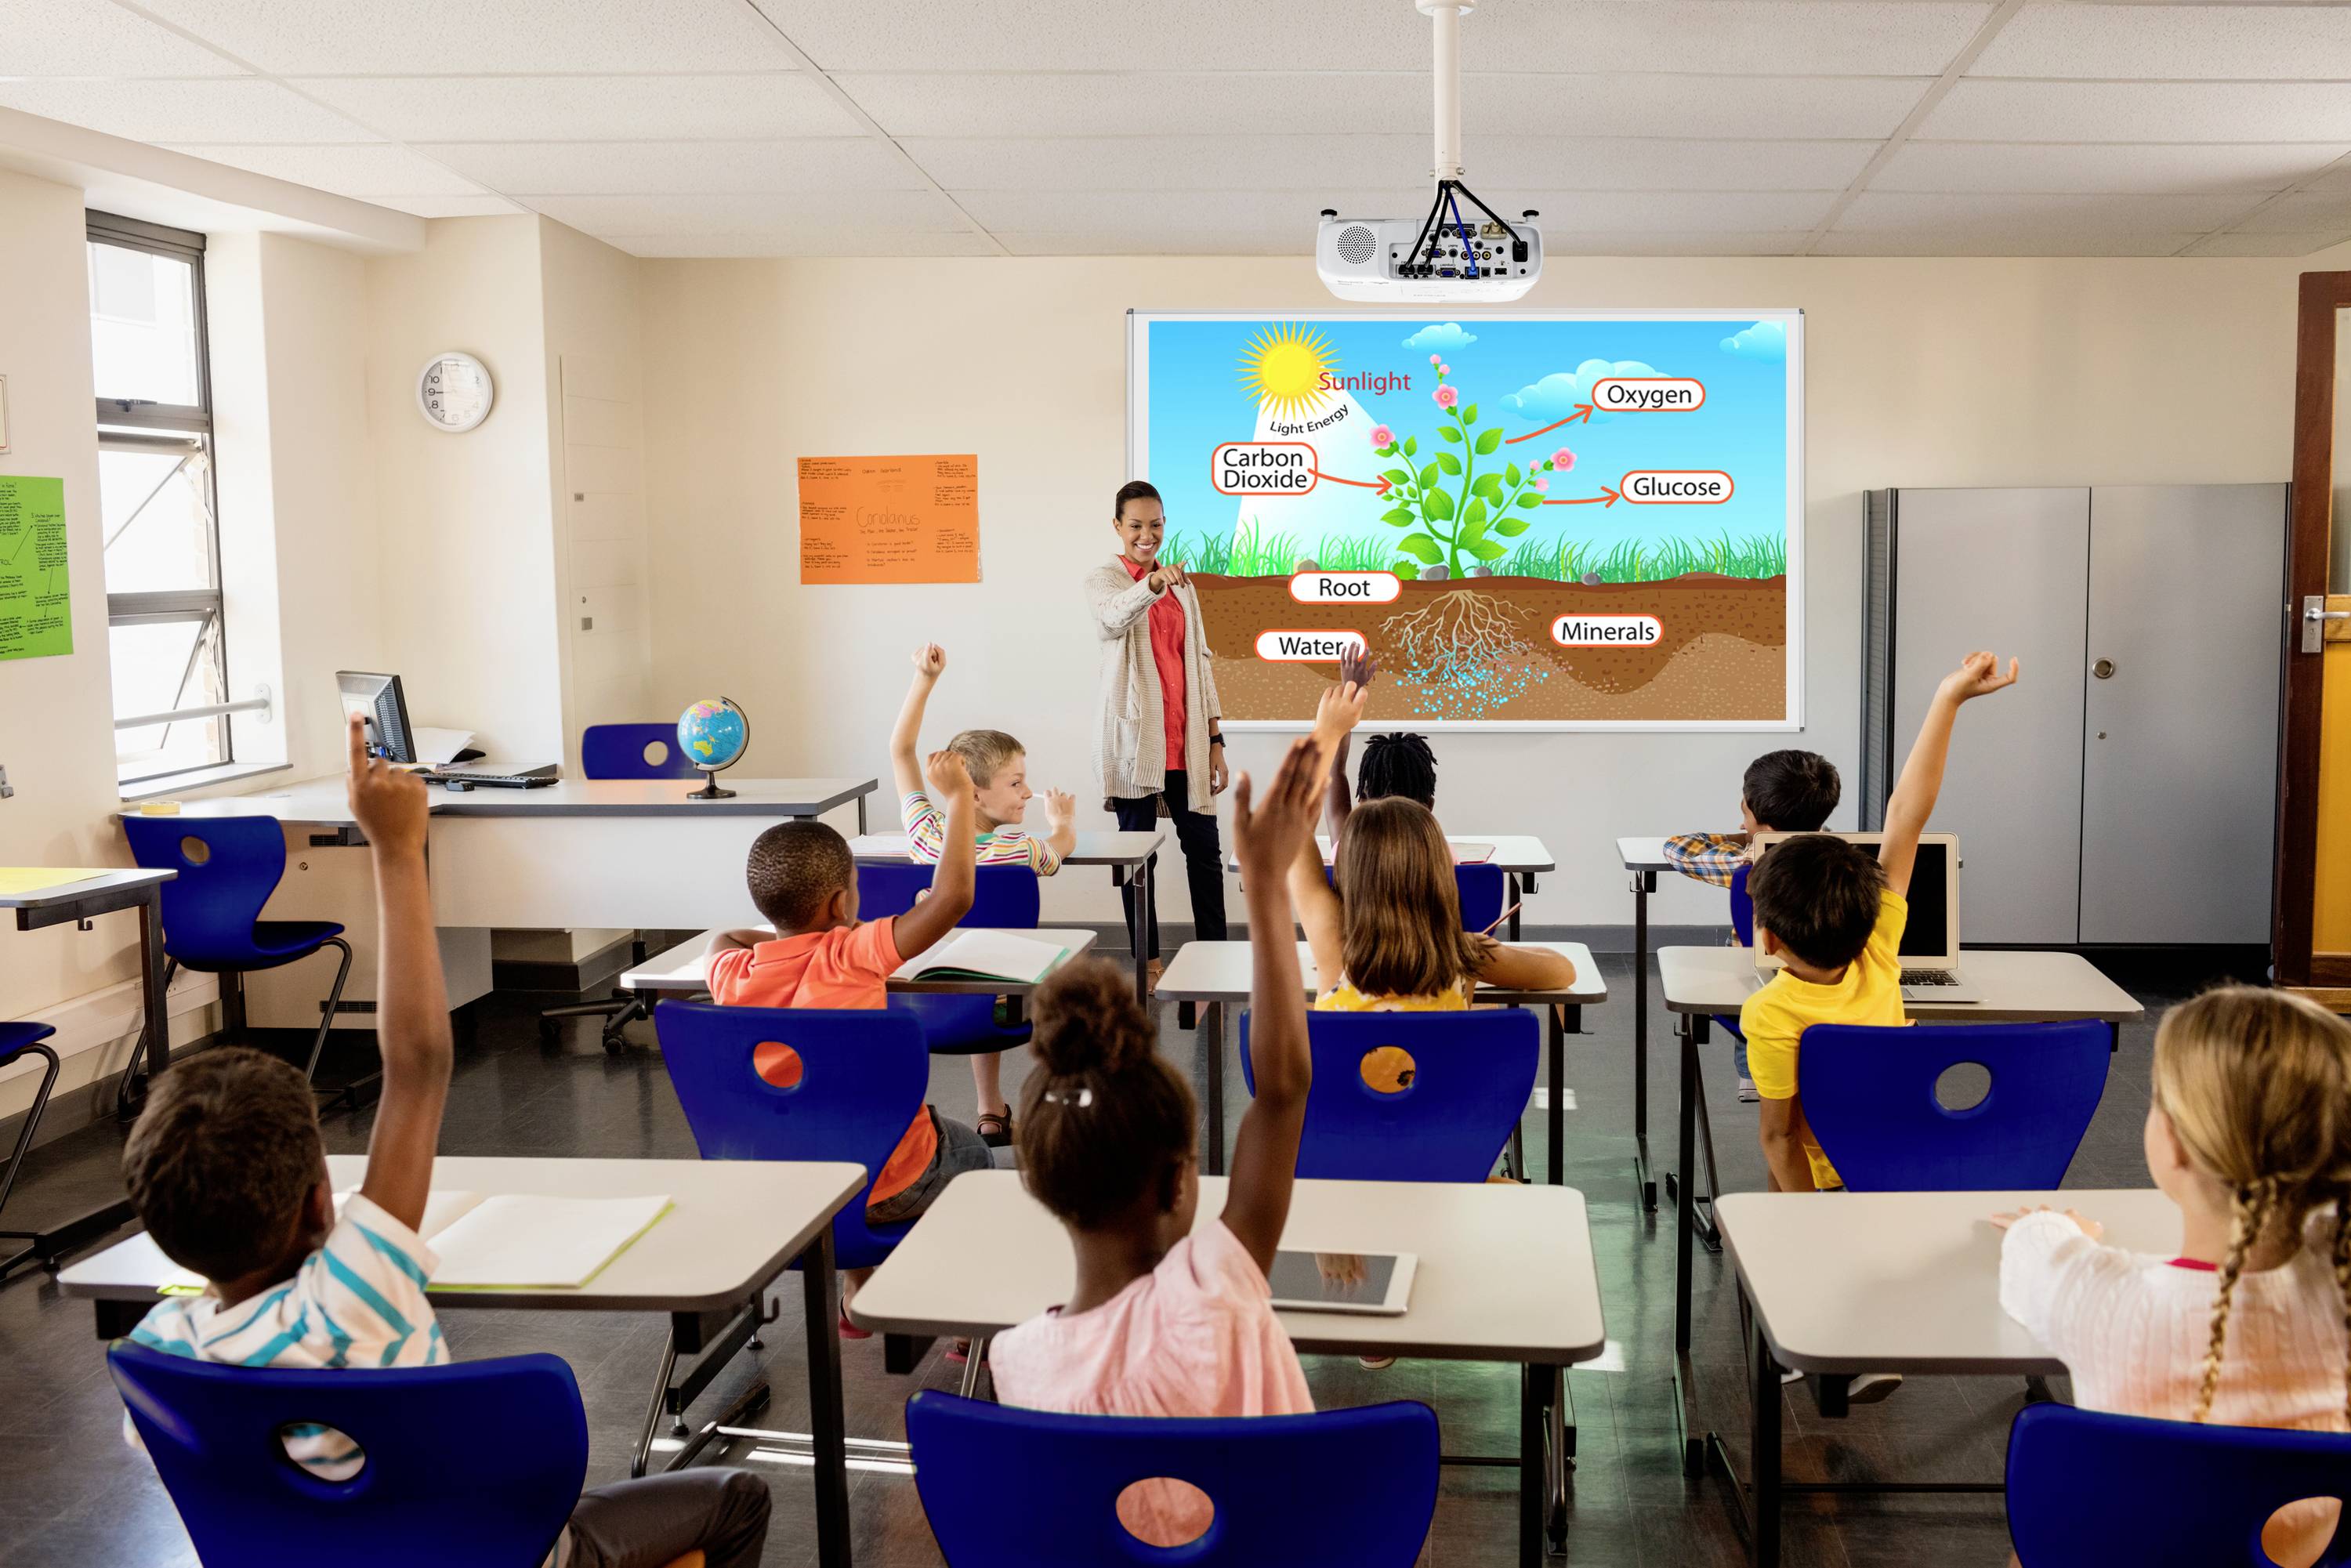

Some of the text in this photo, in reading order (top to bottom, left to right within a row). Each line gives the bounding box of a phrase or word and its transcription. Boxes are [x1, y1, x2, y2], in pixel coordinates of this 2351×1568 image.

[430, 375, 440, 384] 10
[1319, 372, 1411, 396] Sunlight
[428, 388, 436, 397] 9
[1607, 385, 1692, 409] Oxygen
[431, 400, 439, 409] 8
[1270, 404, 1349, 436] Light Energy
[1223, 447, 1303, 467] Carbon
[1224, 469, 1308, 489] Dioxide
[1633, 476, 1721, 497] Glucose
[856, 505, 921, 528] Coriolanus
[1320, 578, 1371, 597] Root
[1562, 621, 1654, 641] Minerals
[1278, 636, 1344, 656] Water
